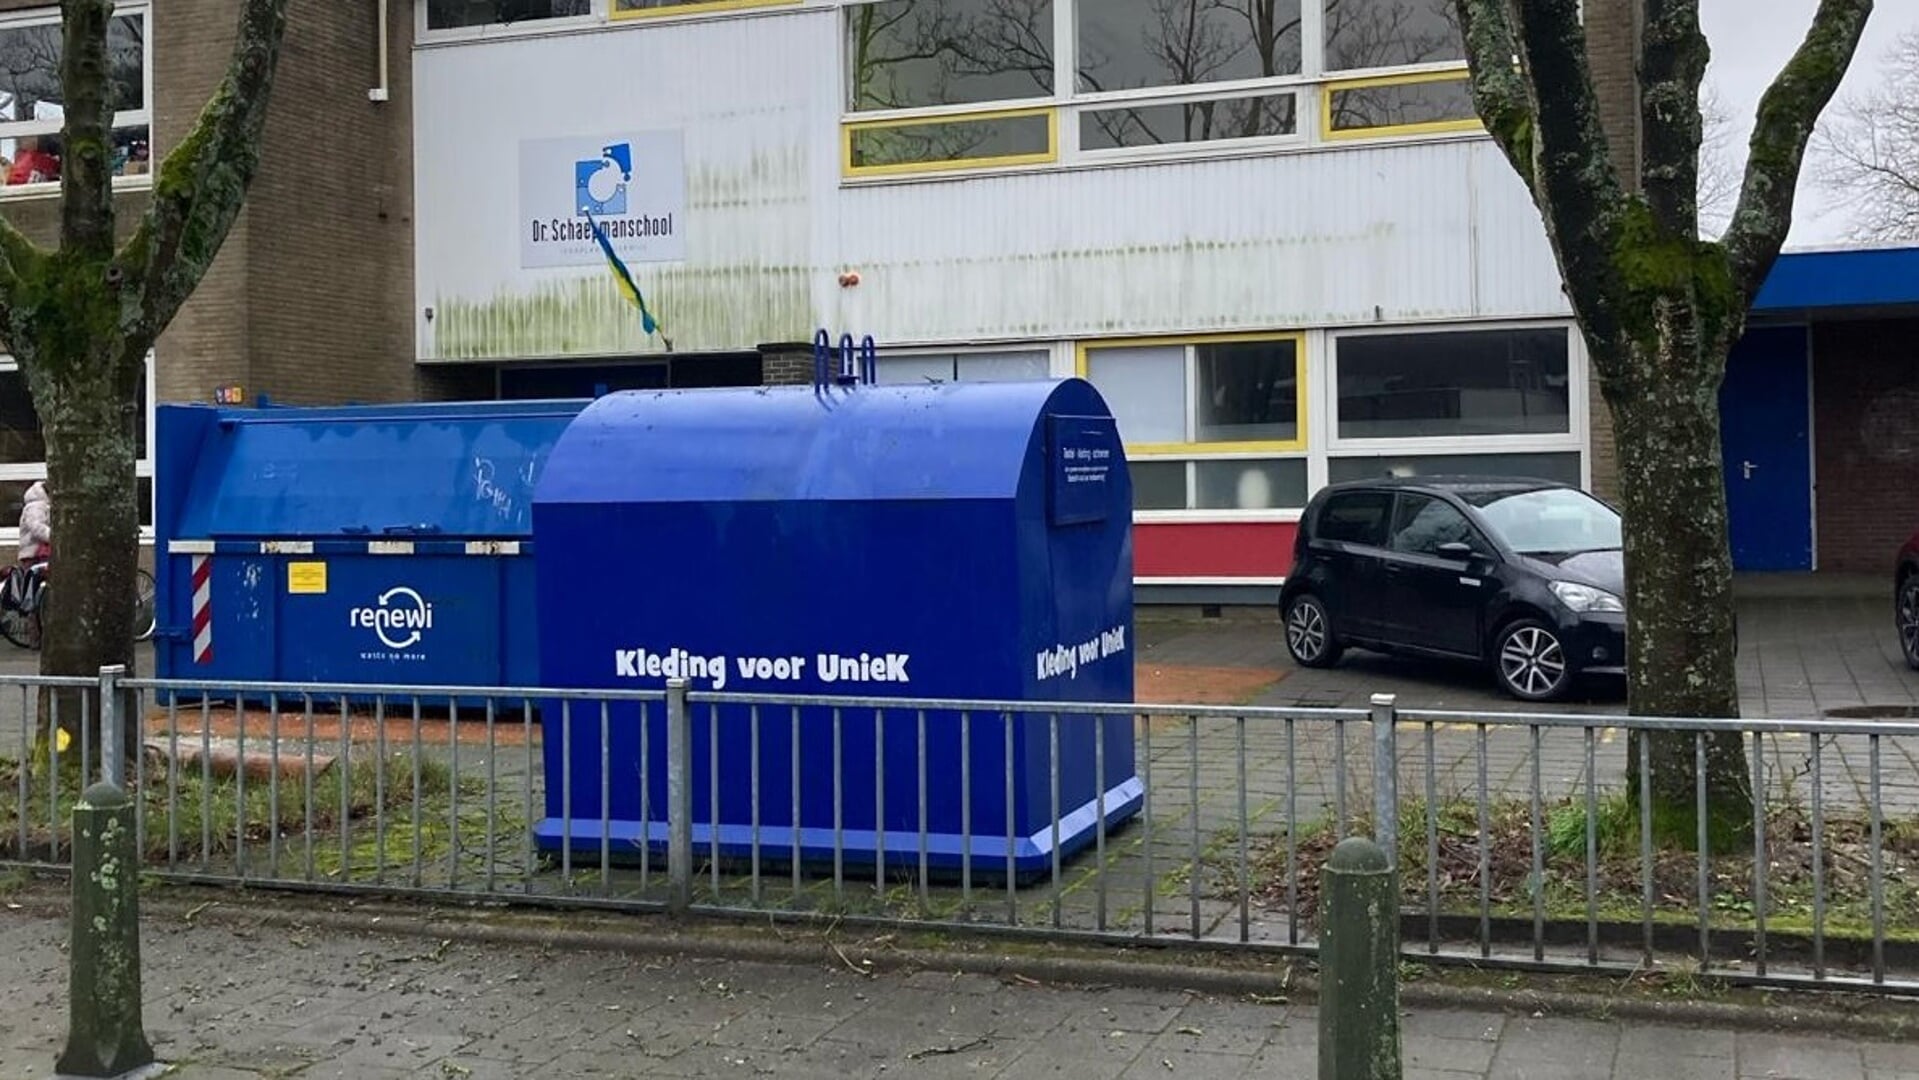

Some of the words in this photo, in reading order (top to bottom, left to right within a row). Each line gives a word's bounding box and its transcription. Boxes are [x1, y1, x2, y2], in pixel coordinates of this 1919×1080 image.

[532, 219, 549, 242] Dr.
[350, 602, 432, 628] renewi
[615, 648, 726, 690] Kleding
[737, 655, 806, 681] voor
[816, 652, 910, 683] UnieK
[1037, 643, 1076, 680] Kleding
[1079, 637, 1099, 665] voor
